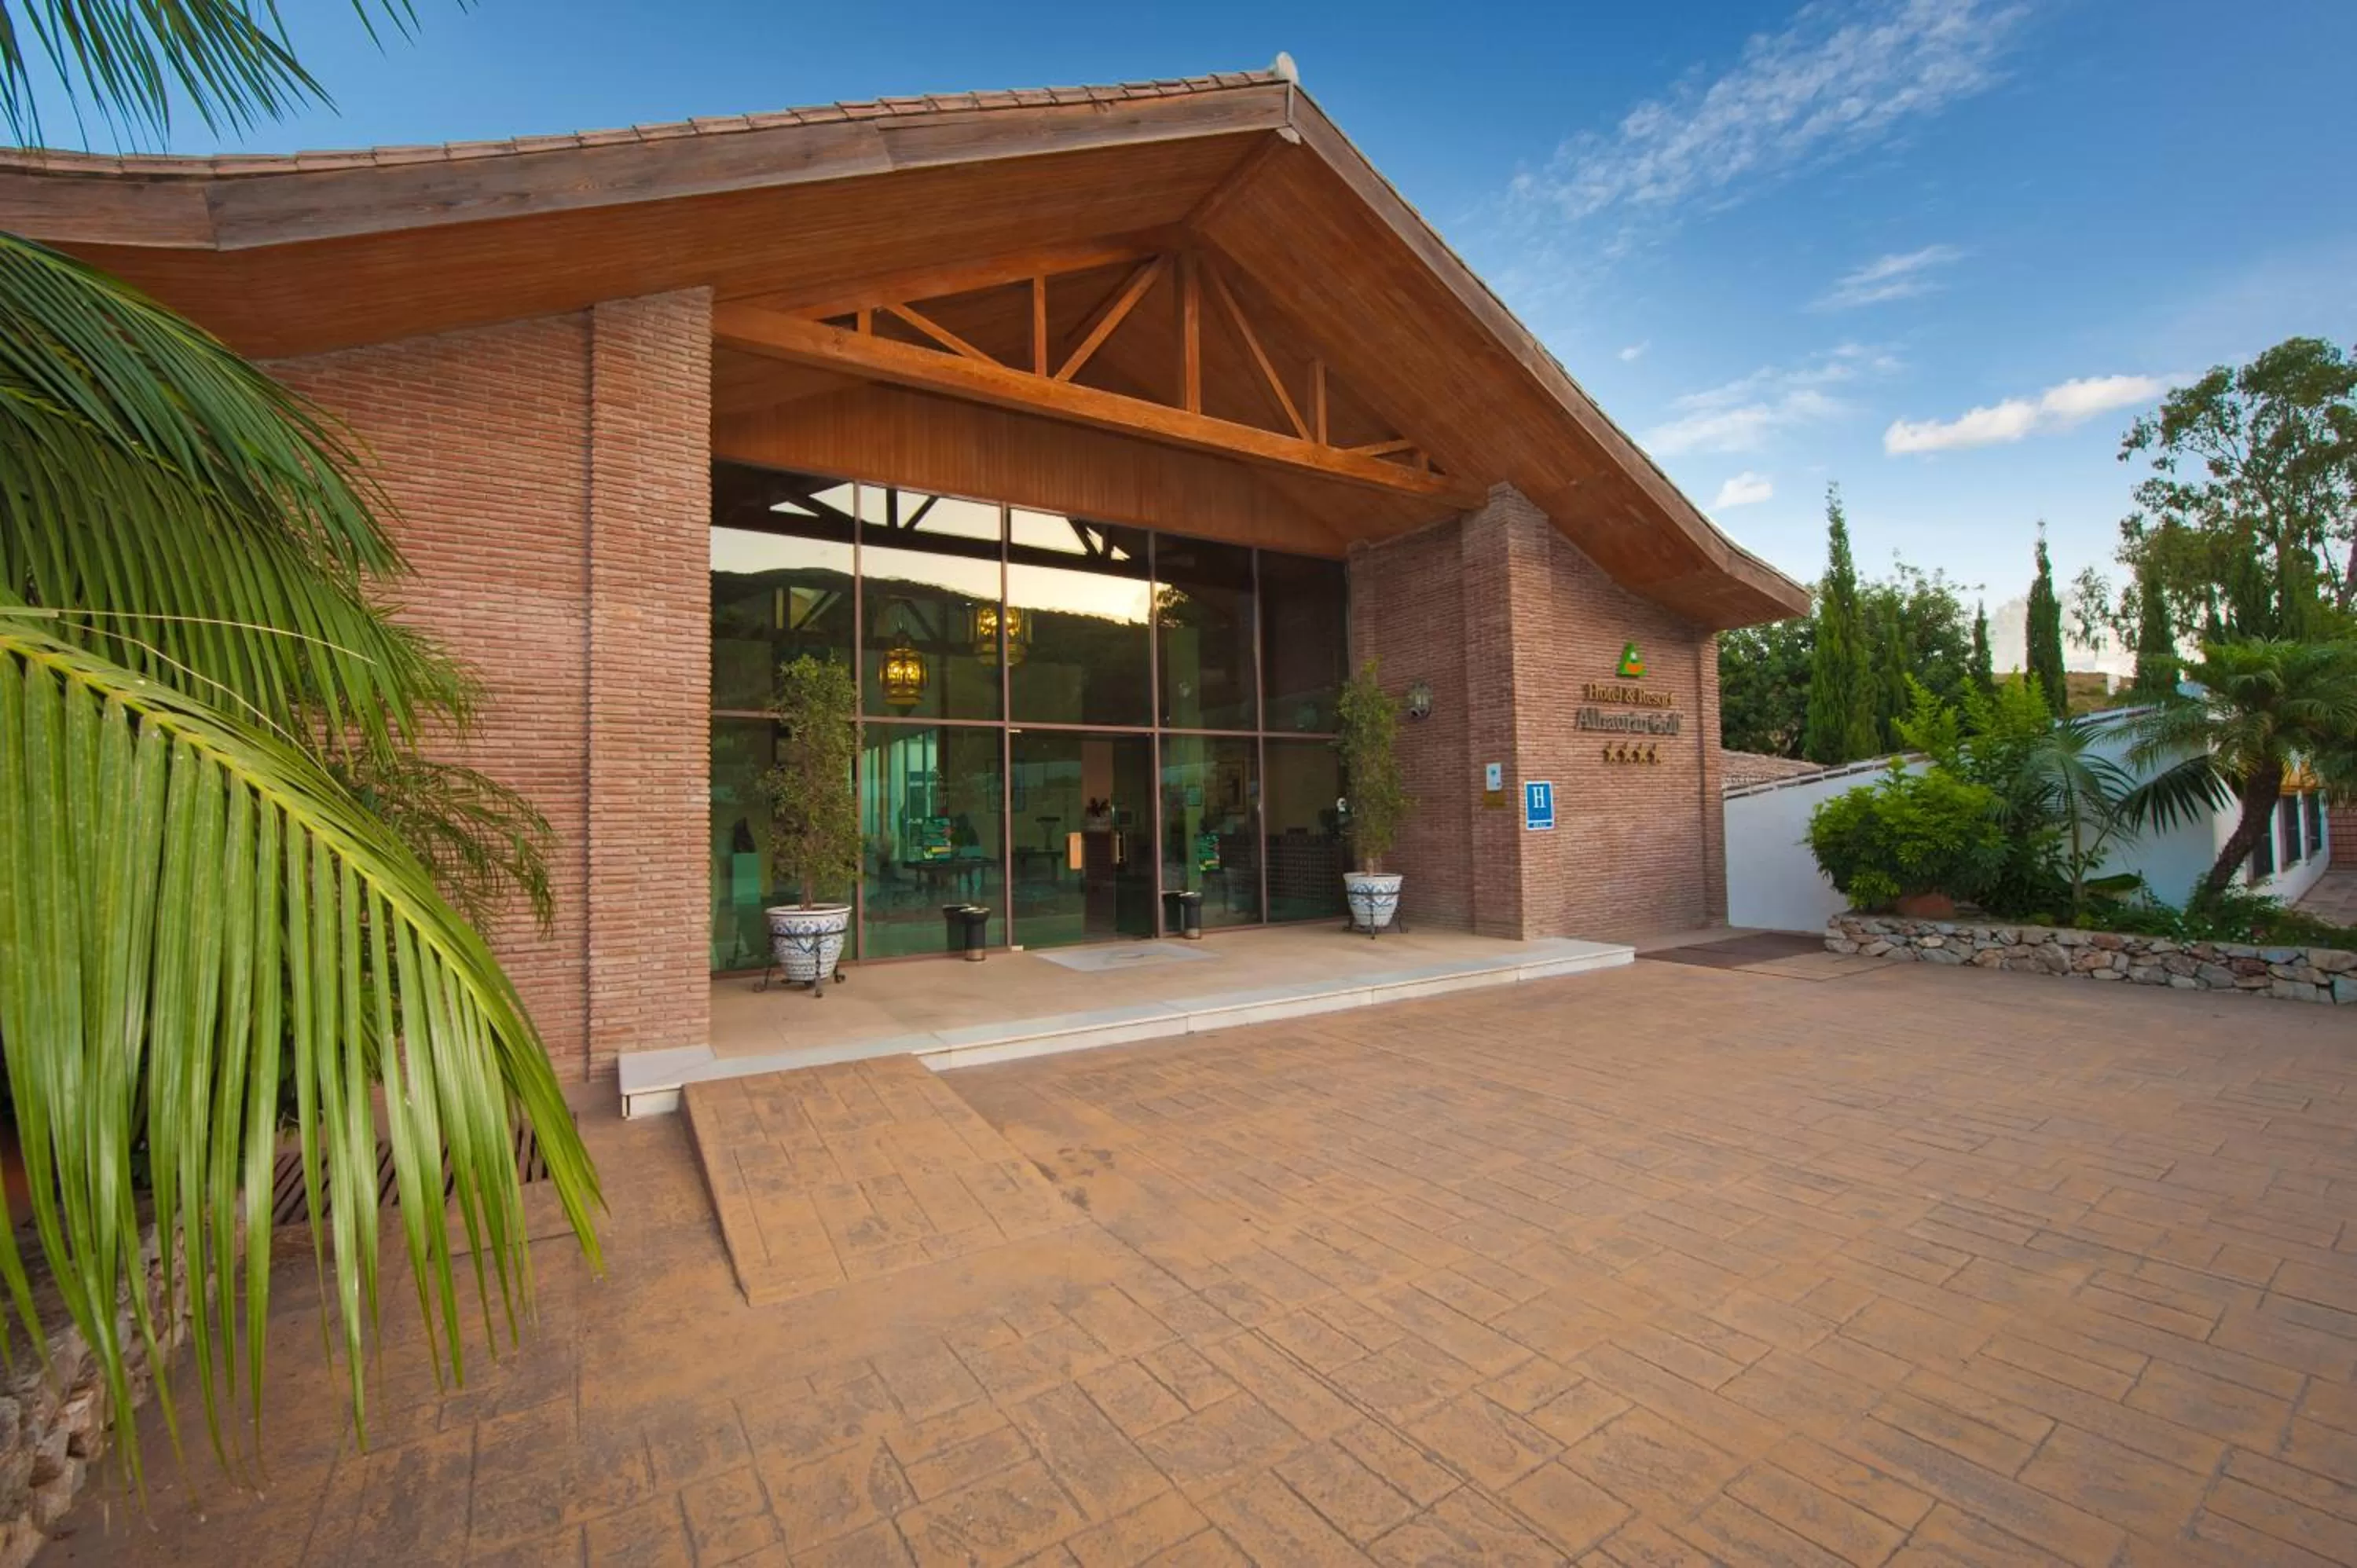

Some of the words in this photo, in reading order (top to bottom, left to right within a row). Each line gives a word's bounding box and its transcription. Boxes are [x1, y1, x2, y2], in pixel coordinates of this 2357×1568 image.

[1588, 683, 1623, 702] Hotel
[1625, 688, 1636, 704] &
[1637, 687, 1675, 706] Resort
[1533, 786, 1546, 808] H
